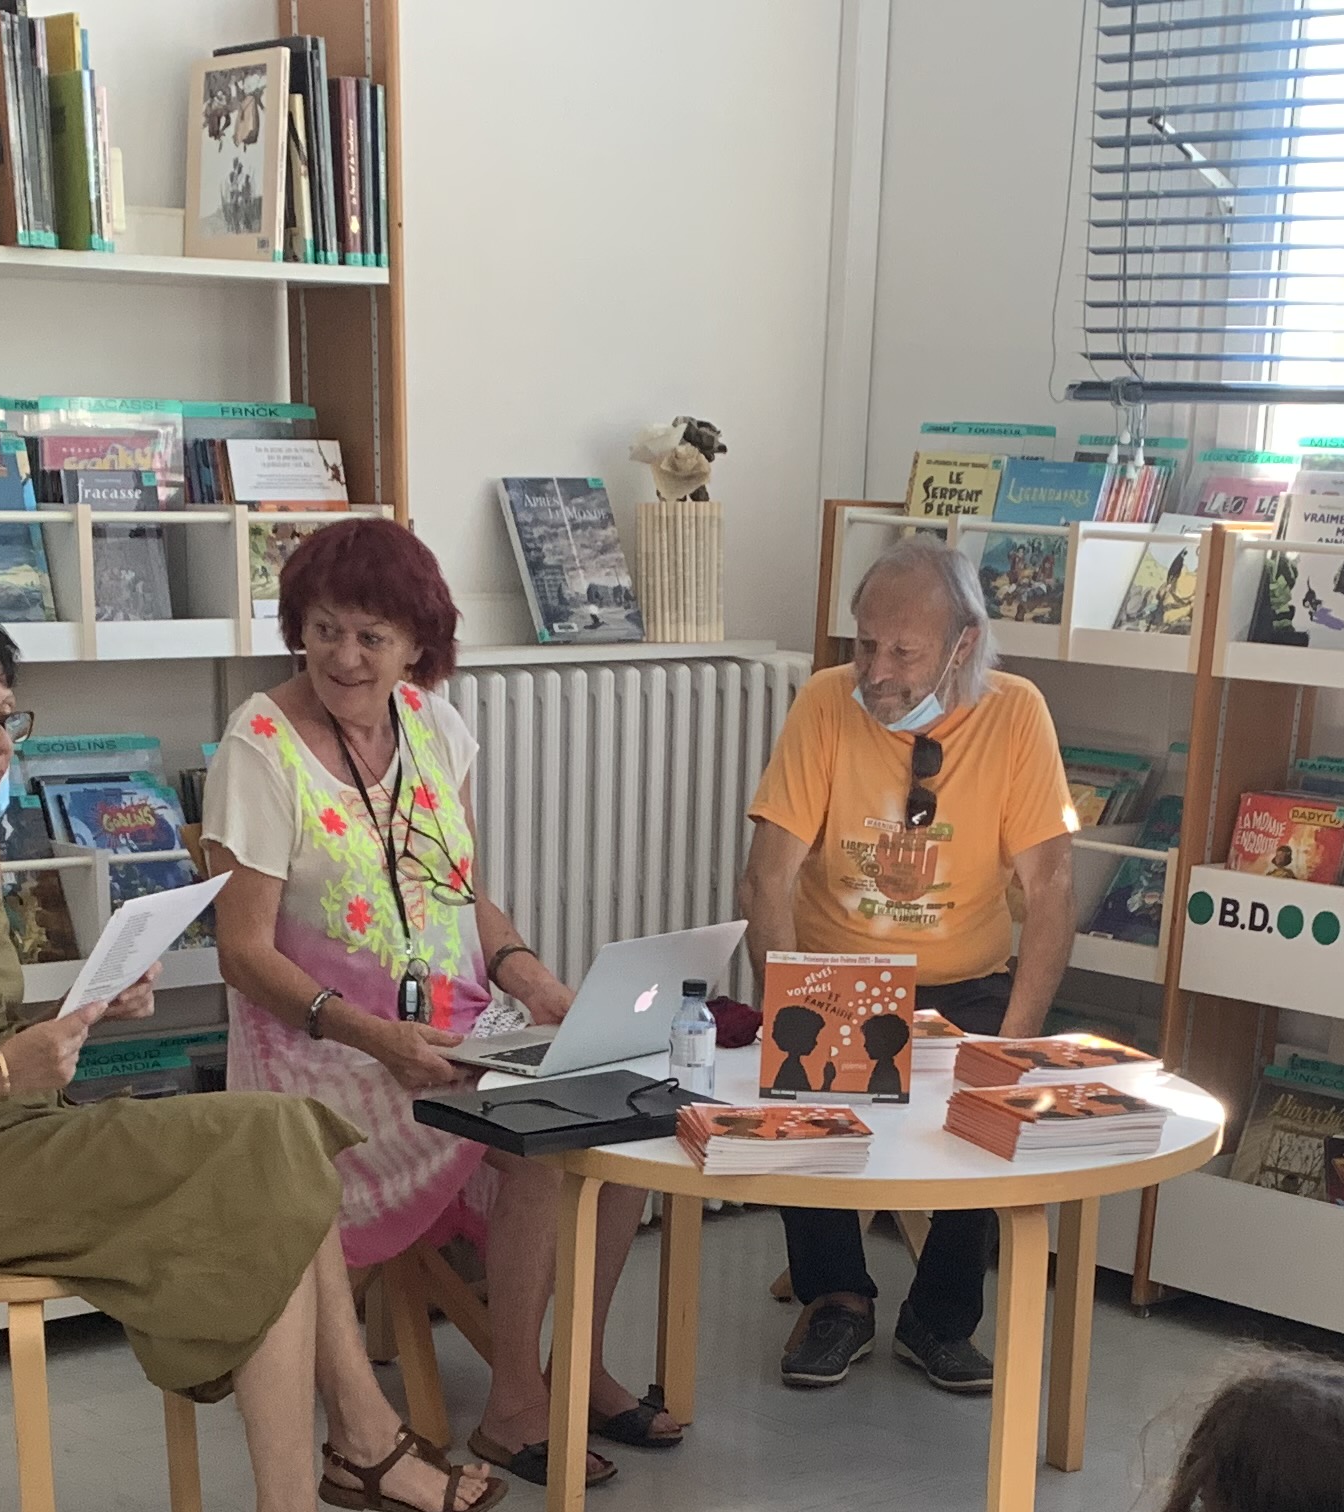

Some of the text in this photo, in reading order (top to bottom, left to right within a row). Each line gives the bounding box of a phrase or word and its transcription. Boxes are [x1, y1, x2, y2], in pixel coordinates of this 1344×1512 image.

[67, 398, 167, 411] FRACASSE
[219, 405, 279, 417] FRNCK
[948, 471, 965, 485] LE
[77, 478, 143, 503] fracasse
[921, 475, 984, 503] SERPENT
[36, 739, 118, 753] GOBLINS
[1218, 896, 1274, 934] B.D.
[786, 981, 832, 997] VOYAGES
[804, 996, 855, 1021] FANTAISIE
[82, 1059, 162, 1077] ISLANDIA
